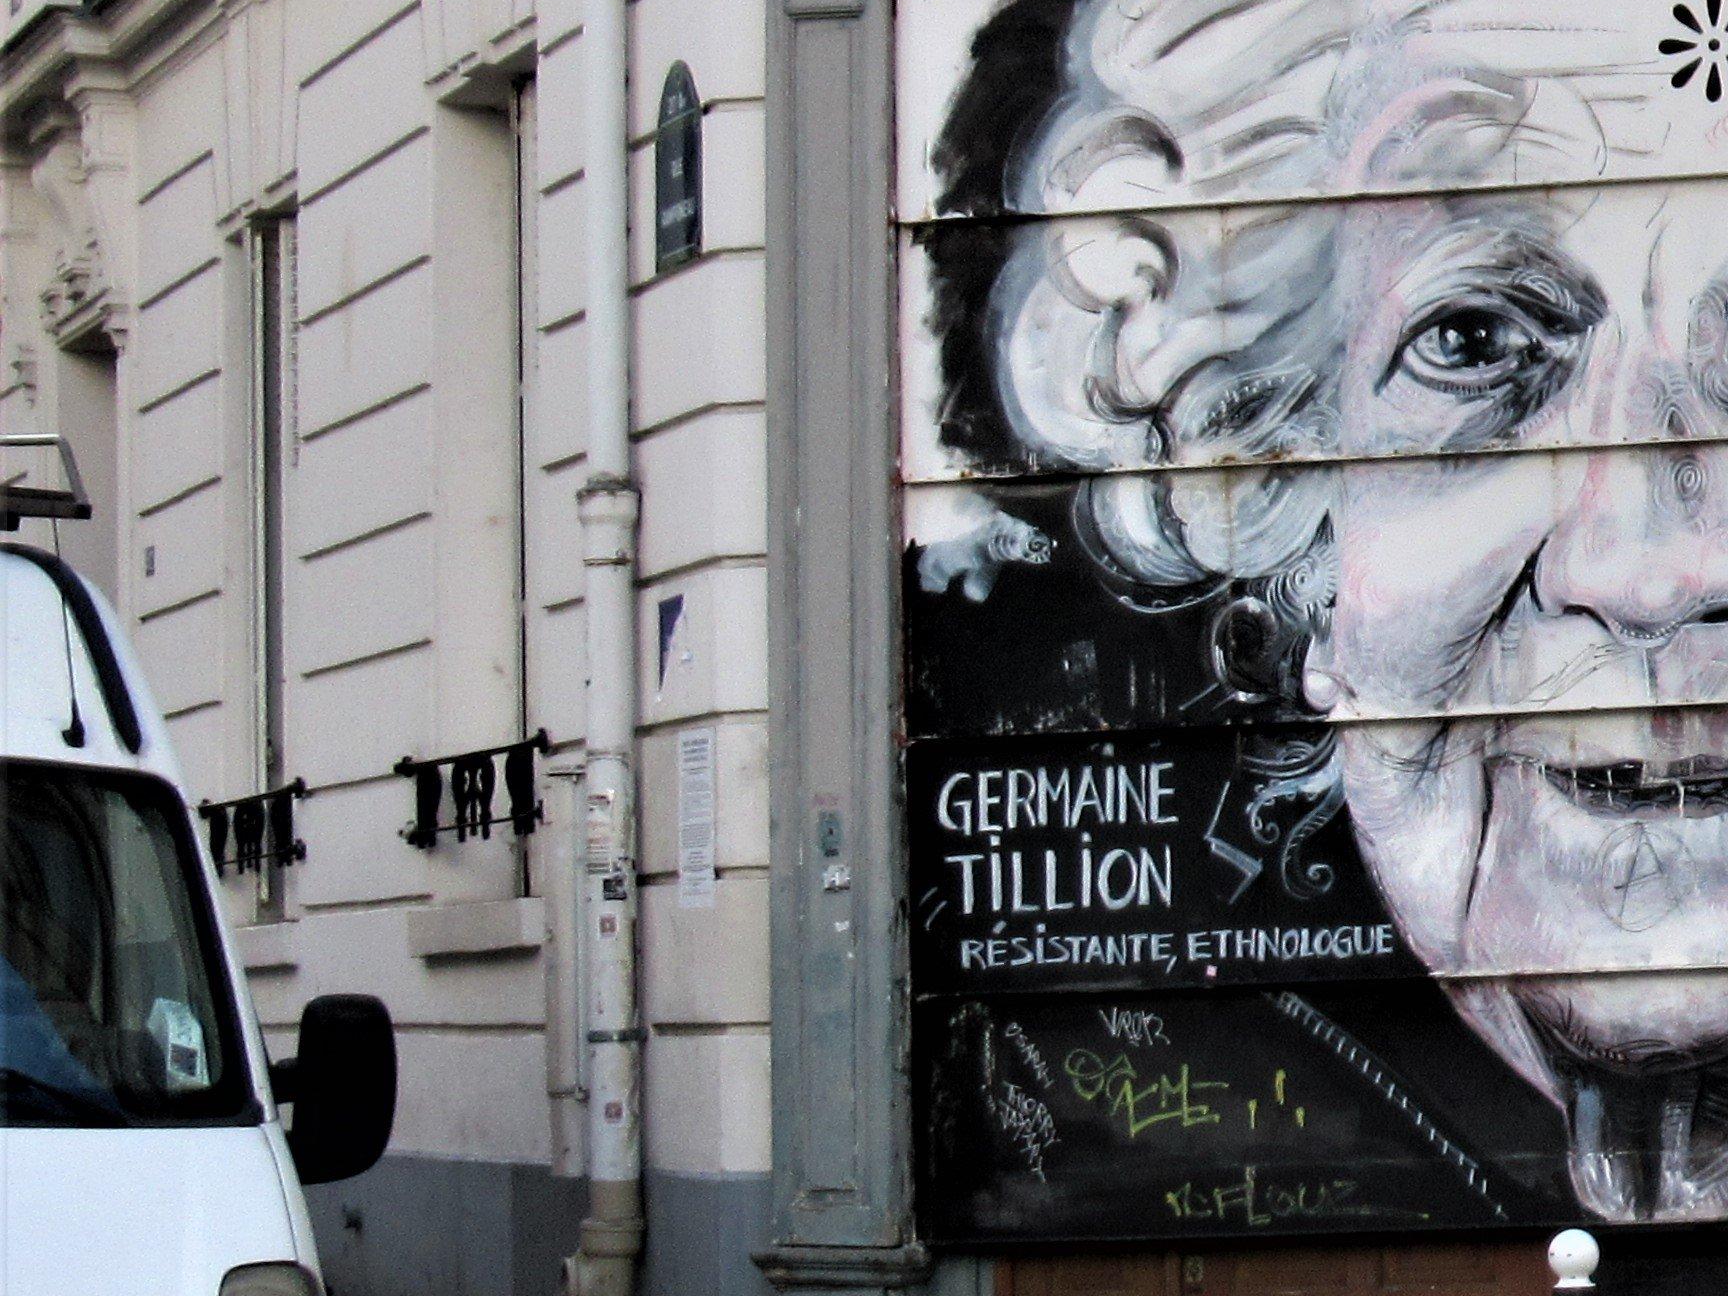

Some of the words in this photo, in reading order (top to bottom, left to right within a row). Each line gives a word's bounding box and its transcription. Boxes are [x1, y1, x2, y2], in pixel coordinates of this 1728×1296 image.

[937, 743, 1180, 837] GERMAINE
[944, 831, 1172, 915] TILLION
[960, 920, 1179, 975] RÉSISTANTE,
[1186, 924, 1394, 963] ETHNOLOGUE
